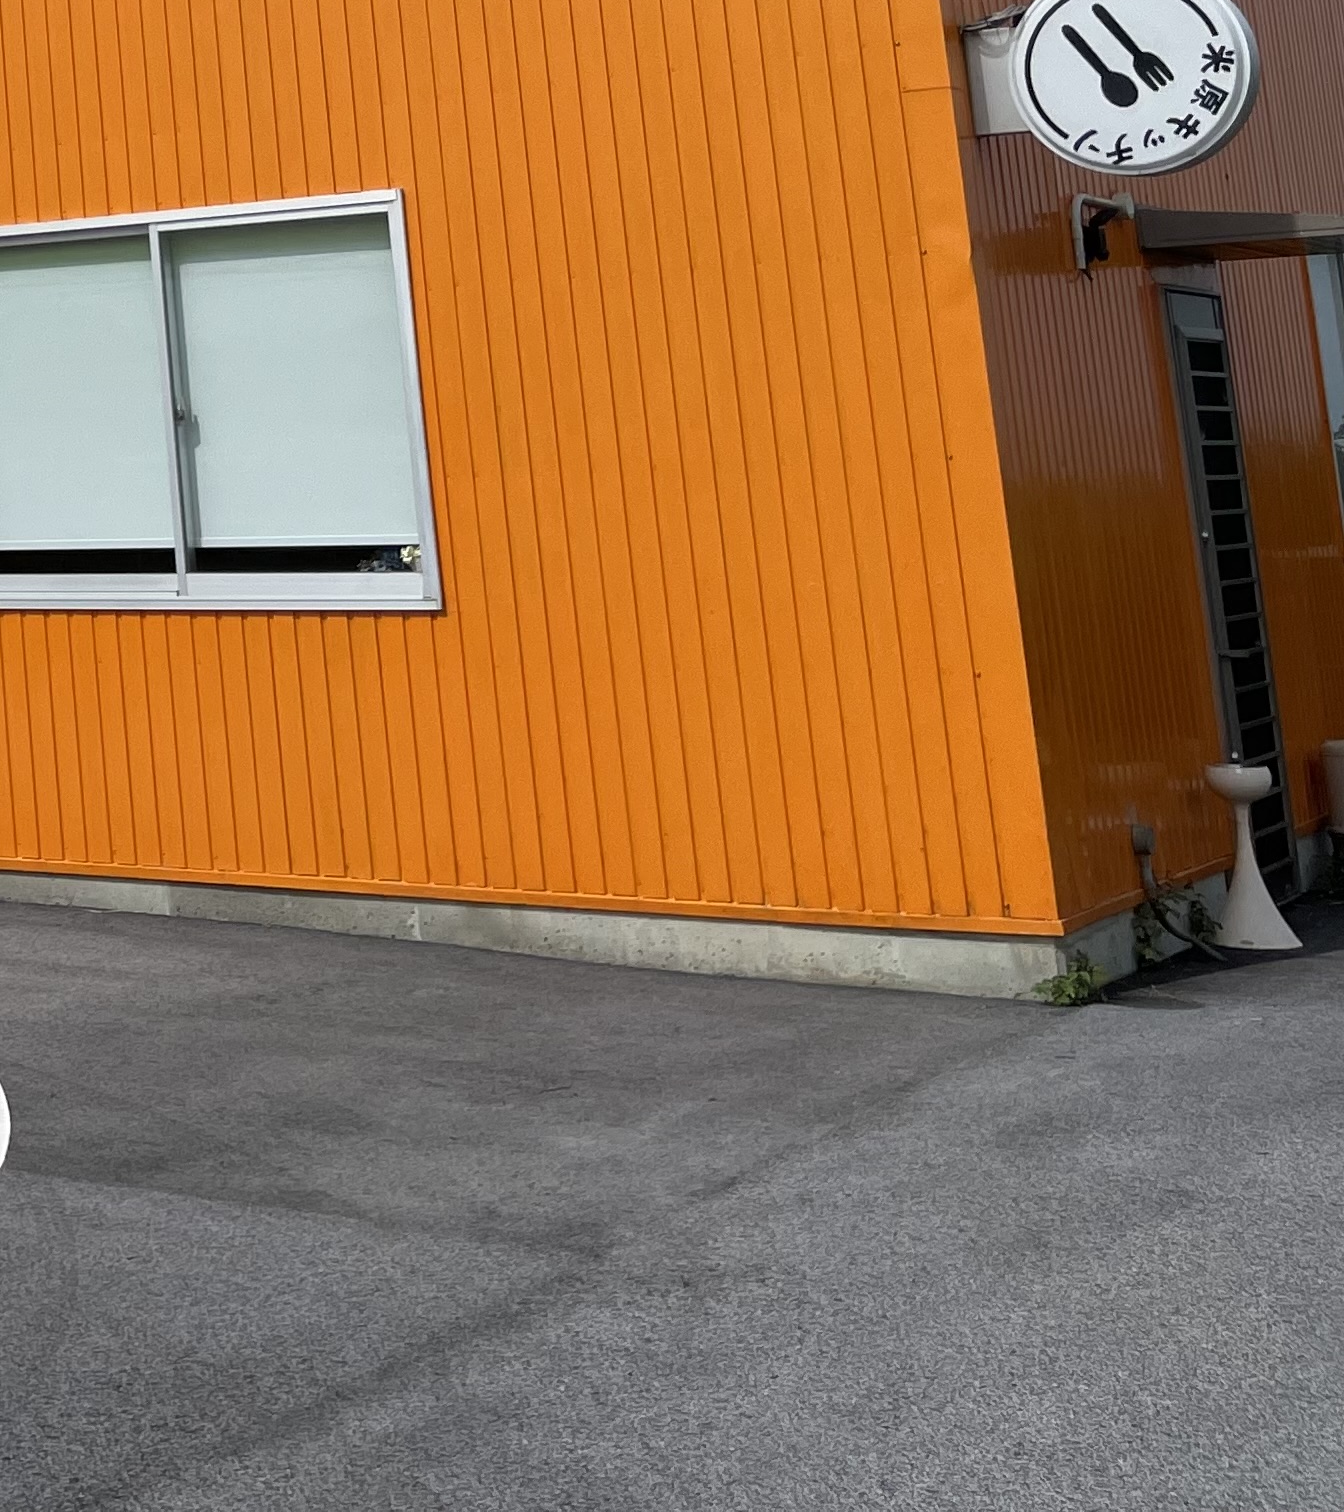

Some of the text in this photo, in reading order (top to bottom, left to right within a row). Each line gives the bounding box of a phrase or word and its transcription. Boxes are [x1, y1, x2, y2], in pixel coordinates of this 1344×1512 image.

[1074, 43, 1235, 165] 米原キッチン
